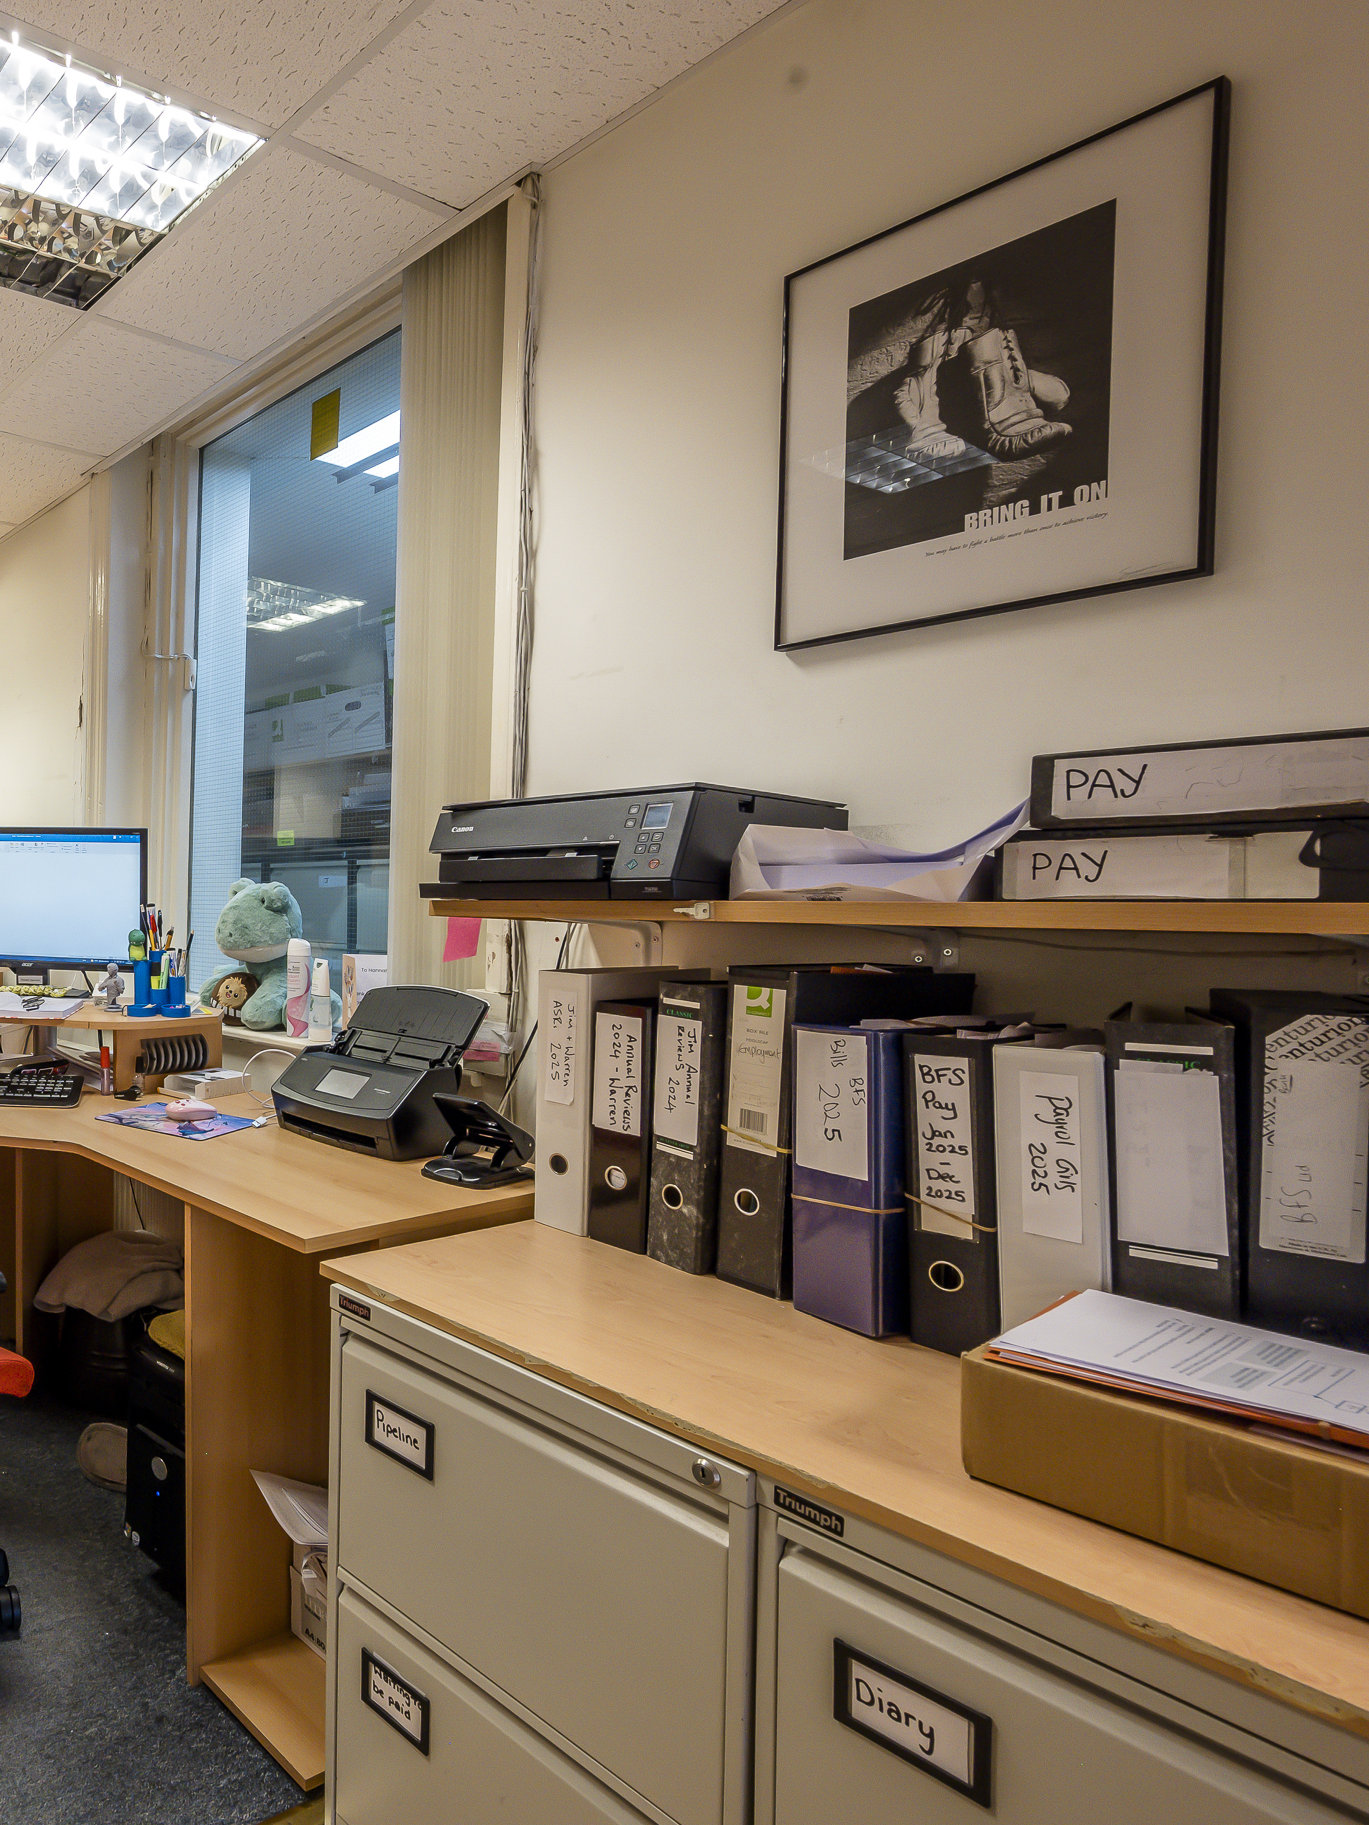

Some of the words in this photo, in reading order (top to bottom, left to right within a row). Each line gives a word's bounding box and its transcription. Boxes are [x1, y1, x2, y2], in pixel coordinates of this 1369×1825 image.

[964, 499, 1030, 531] BRING
[1041, 491, 1063, 514] IT
[1073, 480, 1107, 506] ON
[968, 539, 983, 549] fight
[989, 534, 1006, 542] battle
[1062, 518, 1085, 526] achieve
[1064, 763, 1149, 801] PAY
[1031, 849, 1109, 883] PAY
[567, 1003, 576, 1029] Jim
[666, 1009, 694, 1019] CLASSIC
[609, 1023, 623, 1059] 2024
[625, 1034, 638, 1079] Annual
[687, 1028, 698, 1053] Jim
[738, 1043, 782, 1064] Employment
[830, 1039, 848, 1068] Bills
[550, 1042, 562, 1081] 2025
[563, 1046, 575, 1087] Warren
[918, 1063, 966, 1087] BFS
[664, 1077, 680, 1113] 2024
[685, 1063, 699, 1105] Annual
[849, 1077, 867, 1106] BFS
[608, 1077, 624, 1126] Warren
[622, 1085, 638, 1132] Reviews
[818, 1083, 843, 1142] 2025
[921, 1090, 958, 1120] Pay
[921, 1123, 956, 1141] Jan
[924, 1142, 969, 1156] 2025
[924, 1168, 961, 1184] Dec
[1028, 1142, 1050, 1196] 2025
[925, 1185, 966, 1203] 2025
[340, 1296, 370, 1318] Triumph
[376, 1408, 420, 1451] Pipeline
[776, 1489, 842, 1533] Triumph
[305, 1628, 315, 1642] A4
[372, 1680, 384, 1699] be
[854, 1677, 935, 1756] Diary
